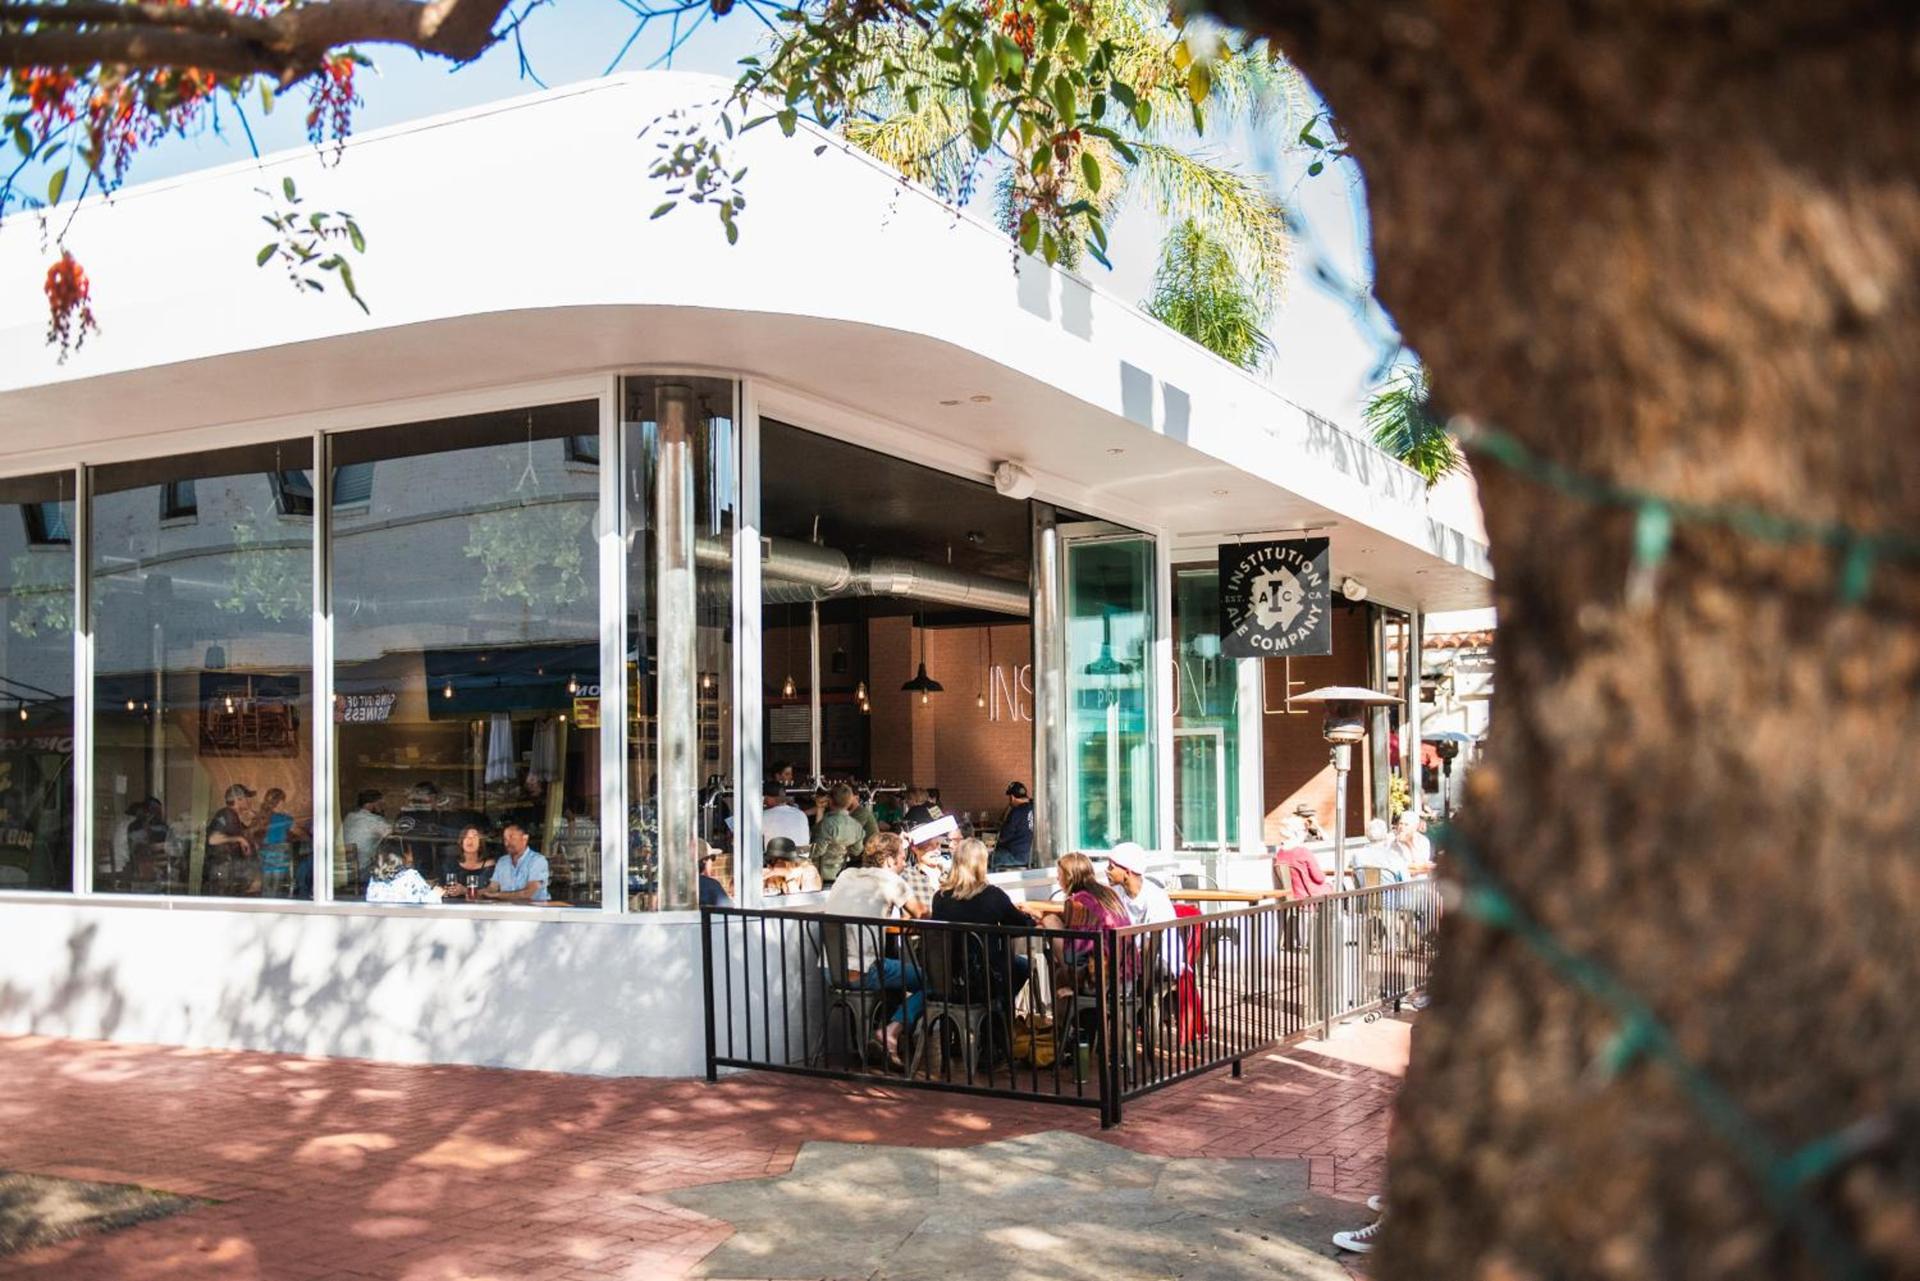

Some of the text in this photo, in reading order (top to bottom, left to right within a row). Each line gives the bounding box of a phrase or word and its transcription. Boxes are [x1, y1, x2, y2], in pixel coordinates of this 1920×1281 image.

[1228, 547, 1322, 591] INSTITUTION
[1227, 604, 1322, 650] ALE COMPANY
